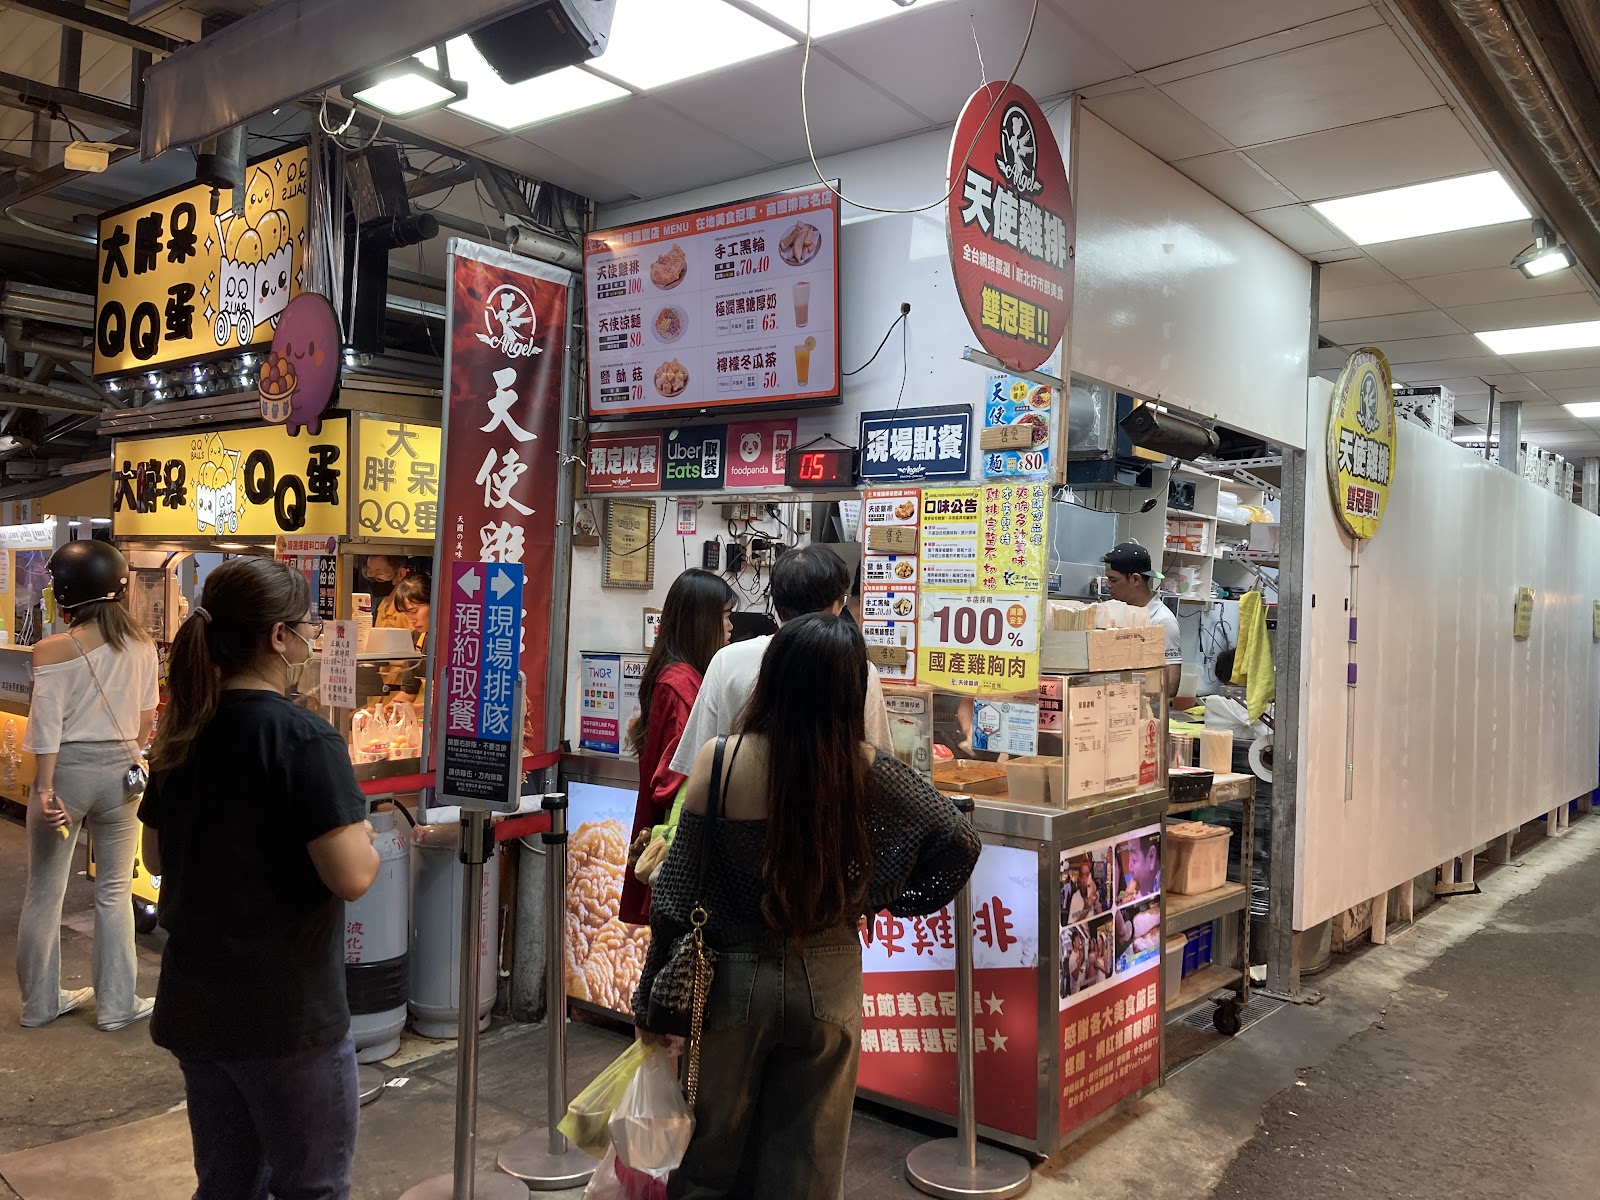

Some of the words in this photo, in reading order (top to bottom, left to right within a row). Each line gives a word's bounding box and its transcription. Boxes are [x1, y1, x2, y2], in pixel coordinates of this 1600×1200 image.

[1005, 162, 1037, 192] Angel
[663, 221, 690, 236] MENU
[962, 168, 1067, 270] 天使雞排
[102, 202, 197, 283] 大胖呆
[715, 236, 764, 260] 手工黑輪
[597, 260, 640, 281] 天使雞排
[740, 258, 753, 276] 70
[756, 255, 769, 273] 40
[628, 277, 642, 295] 100
[715, 293, 777, 317] 極潤黑糖厚奶
[98, 282, 195, 360] QQ蛋
[599, 313, 641, 333] 天使涼麵
[762, 313, 776, 331] 65
[490, 333, 533, 358] Angel
[630, 331, 641, 348] 80
[717, 352, 777, 373] 檸檬冬瓜茶
[631, 384, 643, 400] 70
[763, 371, 777, 389] 50
[191, 439, 202, 450] QQ
[387, 425, 418, 458] 大
[667, 442, 702, 461] Uber
[867, 424, 963, 463] 現場點餐
[191, 452, 205, 460] BALLS
[591, 444, 657, 475] 預定取餐
[704, 442, 719, 476] 取餐
[1339, 429, 1390, 485] 天使雞排
[364, 456, 438, 496] 胖呆
[666, 462, 700, 479] Eats
[731, 464, 769, 476] foodpanda
[114, 458, 187, 514] 大胖呆
[244, 444, 340, 531] QQ蛋
[359, 500, 438, 534] QQ蛋
[925, 498, 978, 514] 口味公告
[1012, 486, 1029, 566] 爽脆多汁美味
[934, 606, 1003, 646] 100
[1008, 632, 1024, 647] %
[449, 603, 481, 733] 預約取餐
[482, 605, 514, 735] 現場排隊
[929, 651, 1026, 679] 國產雞胸肉
[1064, 982, 1157, 1050] 感謝各大美食節目
